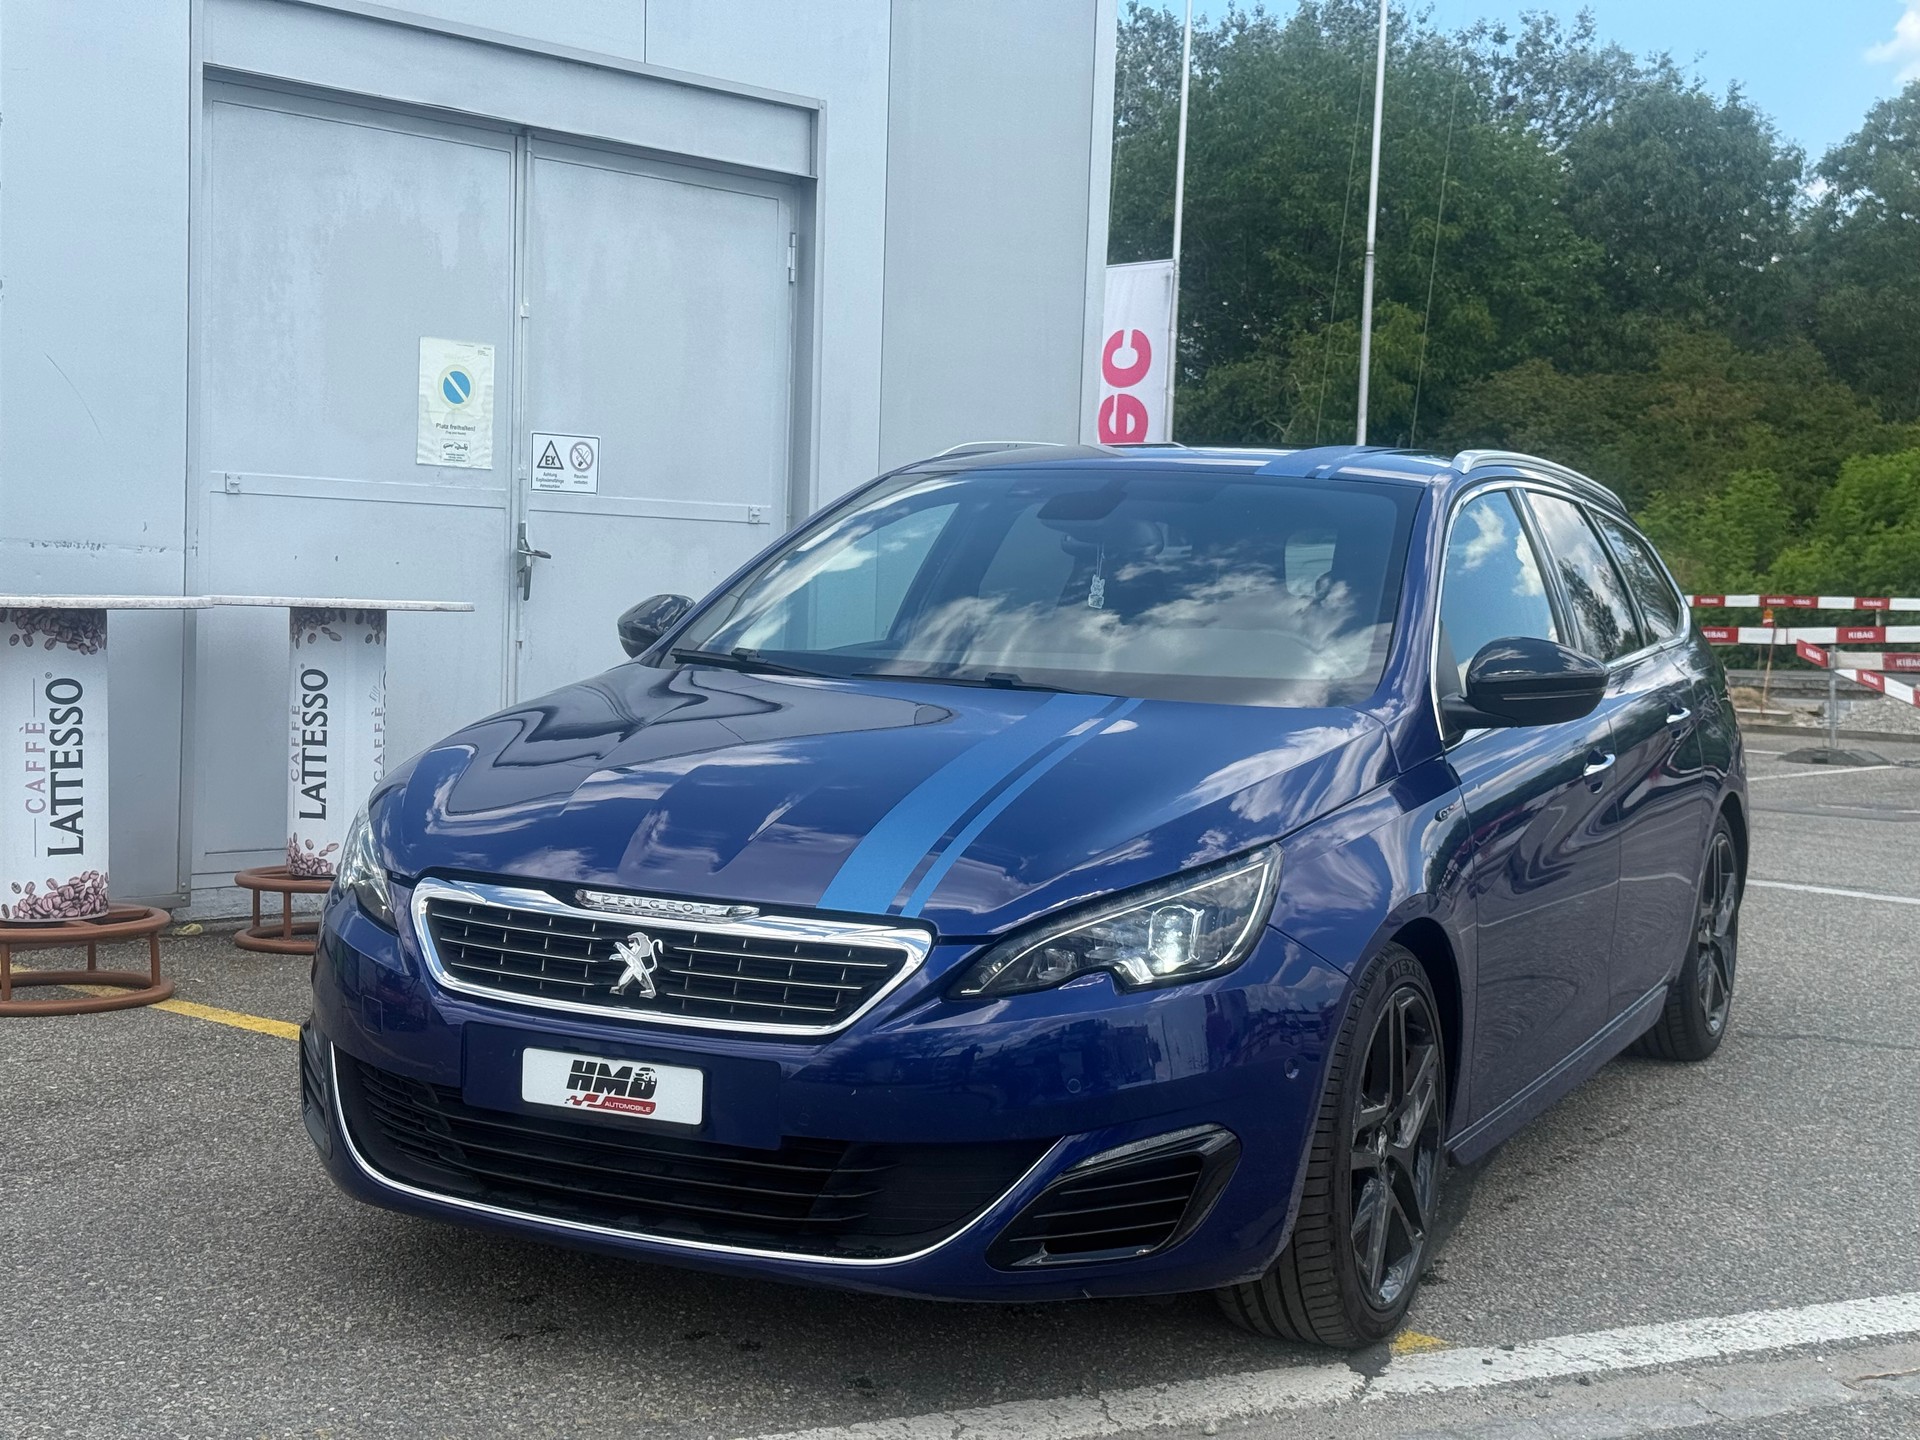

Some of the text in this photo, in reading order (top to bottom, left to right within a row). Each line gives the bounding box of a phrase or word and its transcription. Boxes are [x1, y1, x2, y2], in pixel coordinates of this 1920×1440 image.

[545, 455, 556, 466] EX
[1848, 631, 1875, 639] KIBAG
[299, 668, 329, 821] LATTESSO
[19, 722, 47, 814] CAFFÈ
[45, 678, 84, 857] LATTESSO
[600, 894, 711, 915] PEUGEOT
[604, 1100, 652, 1113] AUTOMOBILE
